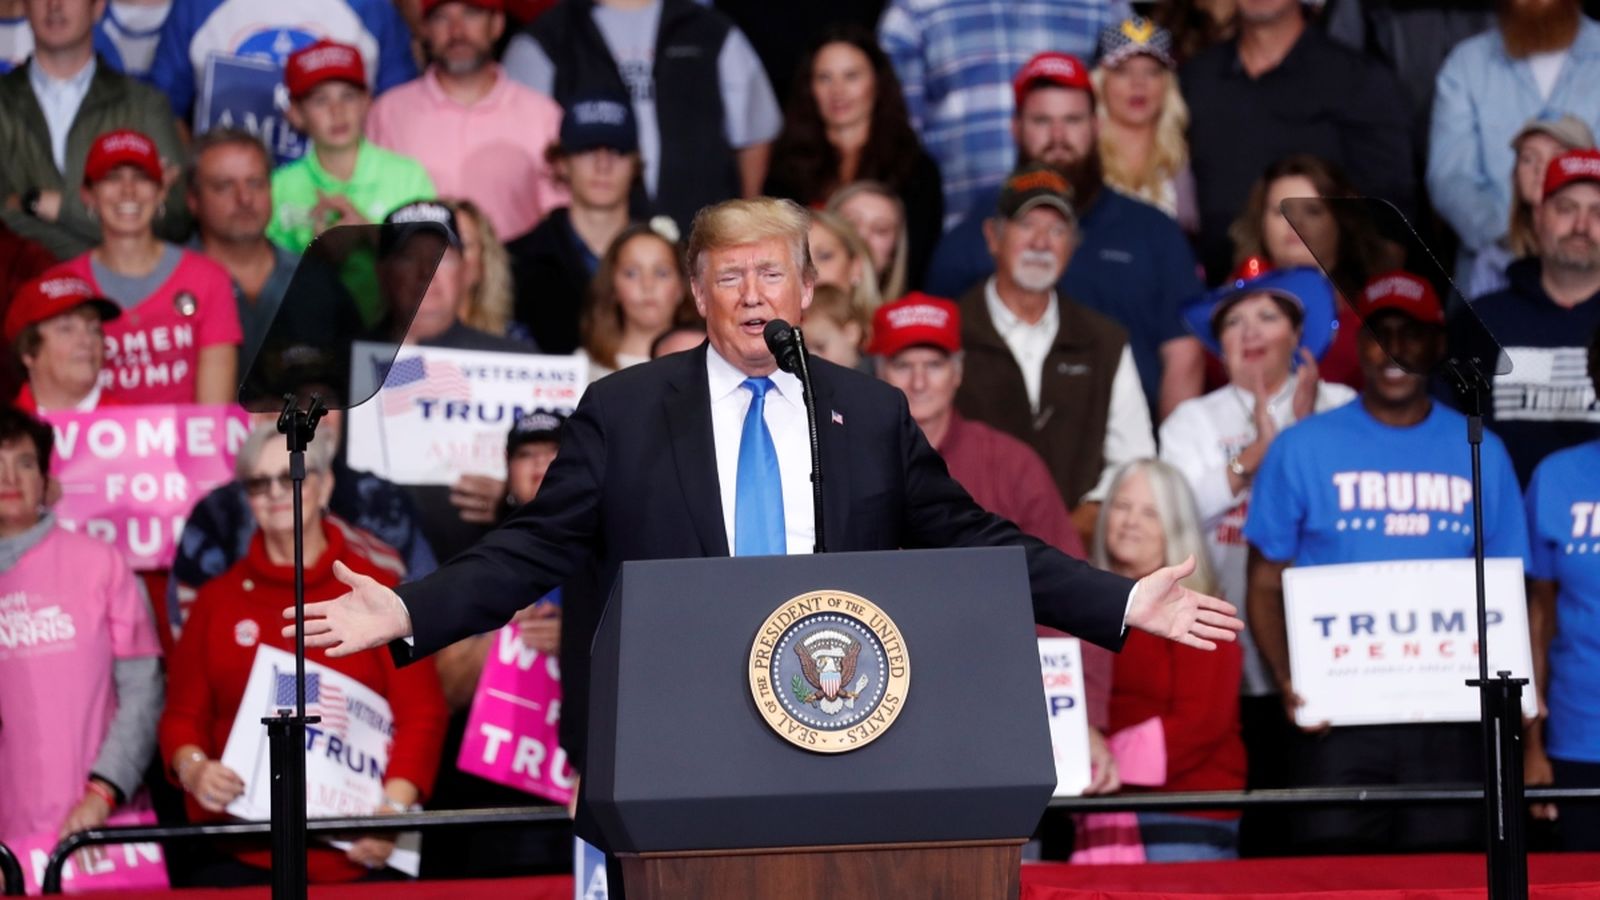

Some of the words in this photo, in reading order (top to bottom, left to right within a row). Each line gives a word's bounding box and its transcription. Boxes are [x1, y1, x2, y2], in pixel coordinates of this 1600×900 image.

[105, 324, 193, 358] OMEN
[100, 360, 188, 389] RUMP
[105, 472, 187, 503] FOR
[1332, 471, 1472, 515] TRUMP
[1384, 512, 1430, 537] 2020
[827, 598, 842, 608] OF
[845, 600, 866, 617] THE
[755, 597, 822, 669] PRESIDENT
[1312, 610, 1504, 638] TRUMP
[868, 614, 905, 679] UNITED
[756, 675, 770, 698] THE
[778, 712, 818, 745] SEAL
[846, 693, 900, 744] STATES
